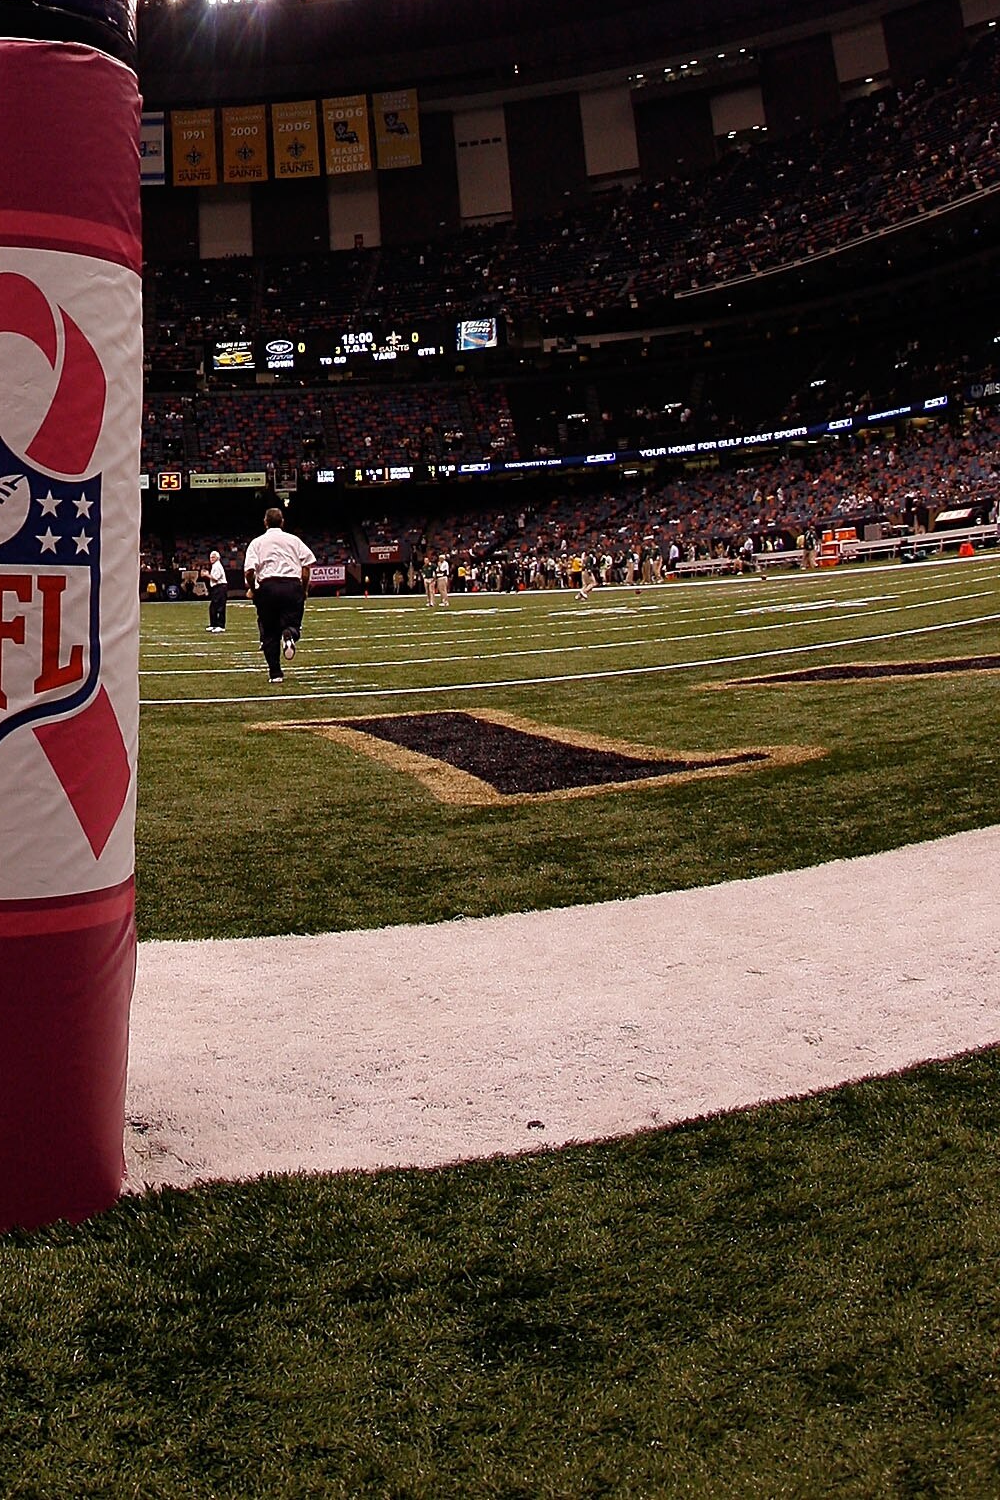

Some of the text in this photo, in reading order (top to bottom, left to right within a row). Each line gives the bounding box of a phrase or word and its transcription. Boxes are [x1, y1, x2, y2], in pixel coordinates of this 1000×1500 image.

[327, 108, 363, 121] 2006
[231, 126, 259, 136] 2000
[278, 121, 311, 133] 2006
[183, 131, 205, 141] 1991
[280, 162, 314, 173] SAINTS
[178, 171, 211, 182] SAINTS
[229, 169, 262, 179] SAINTS
[341, 332, 373, 345] 15:00
[297, 342, 306, 353] 0
[268, 359, 294, 369] DOWN
[320, 357, 333, 365] TO
[372, 352, 397, 361] YARD
[639, 426, 808, 457] YOUR HOME FOR GULF COAST SPORTS
[161, 474, 178, 488] 25
[312, 567, 340, 576] CATCH
